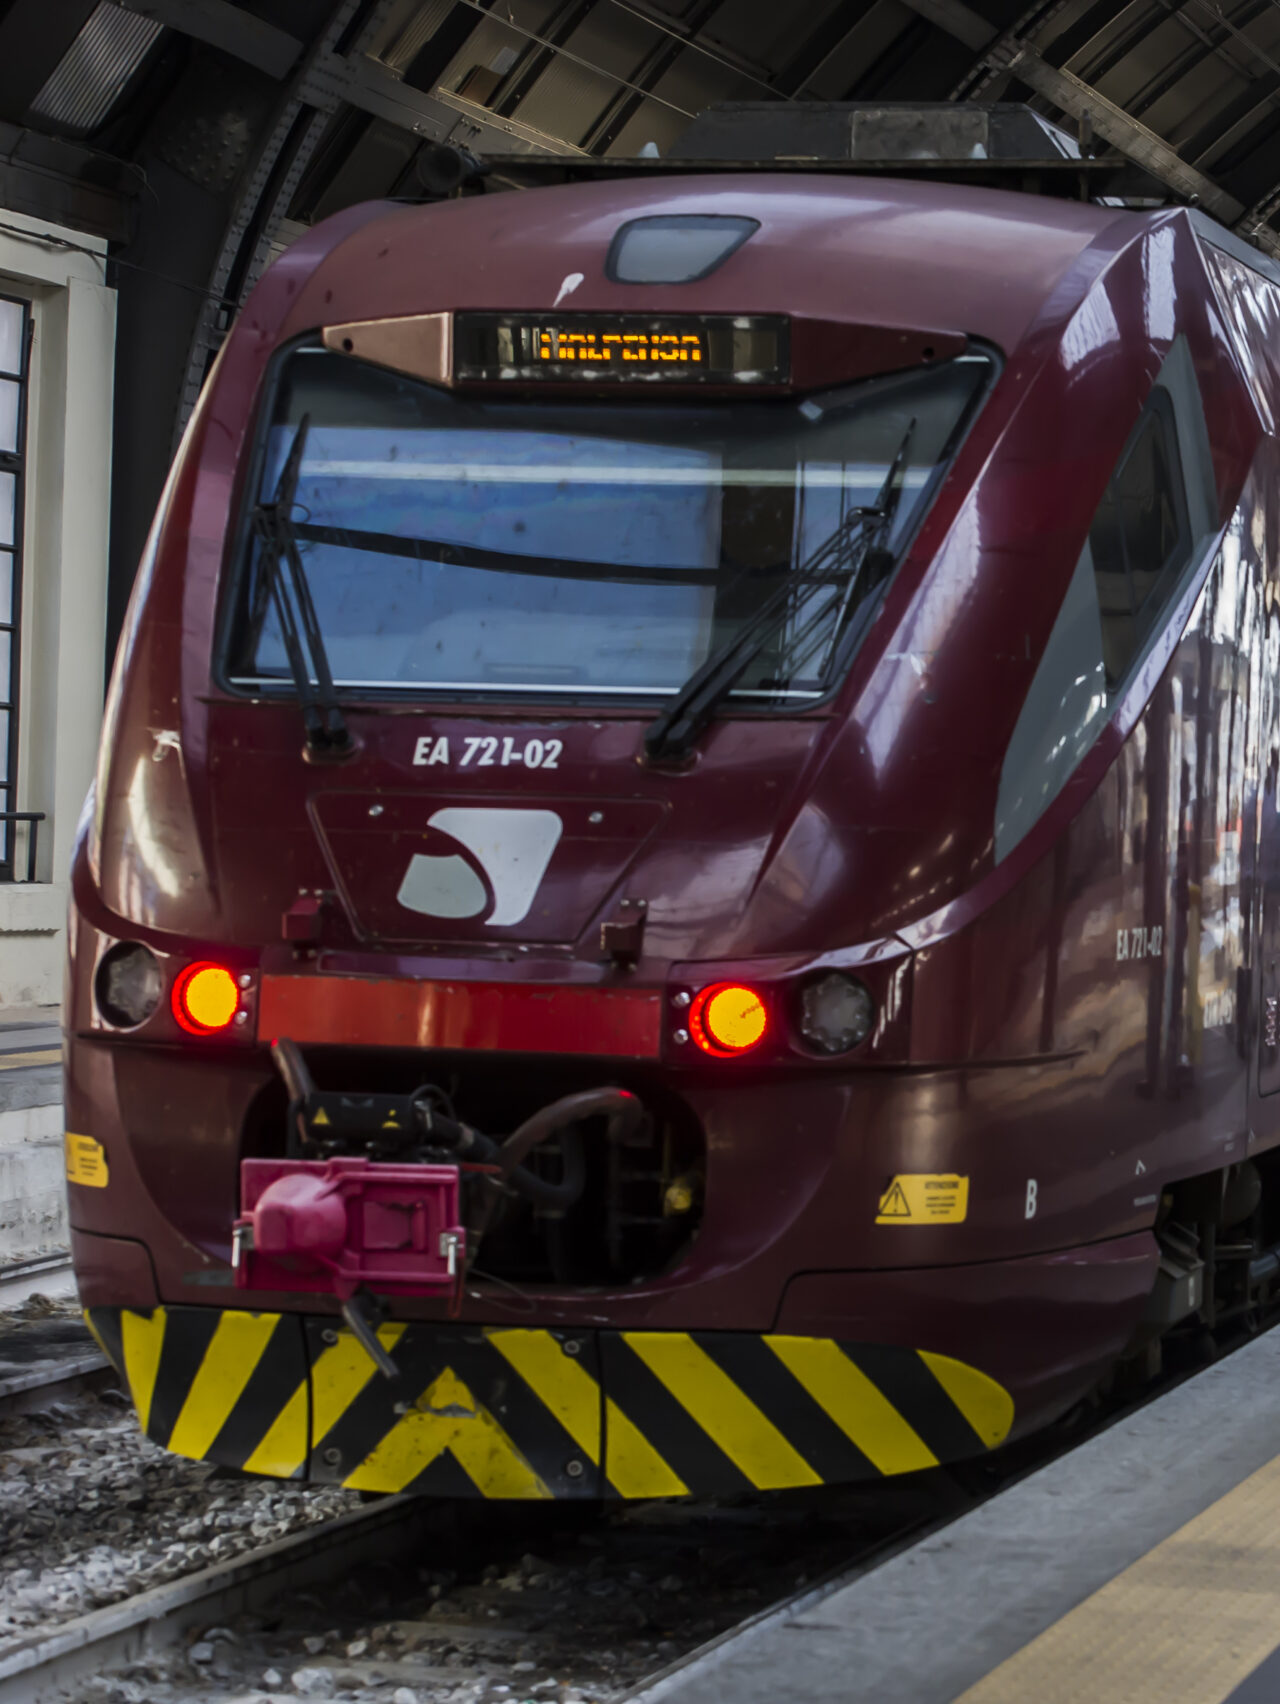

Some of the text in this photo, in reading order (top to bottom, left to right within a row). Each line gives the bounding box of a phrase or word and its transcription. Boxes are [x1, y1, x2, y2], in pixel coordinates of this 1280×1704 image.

[412, 736, 563, 769] EA 721-02
[1116, 928, 1129, 961] EA
[1024, 1178, 1038, 1220] B
